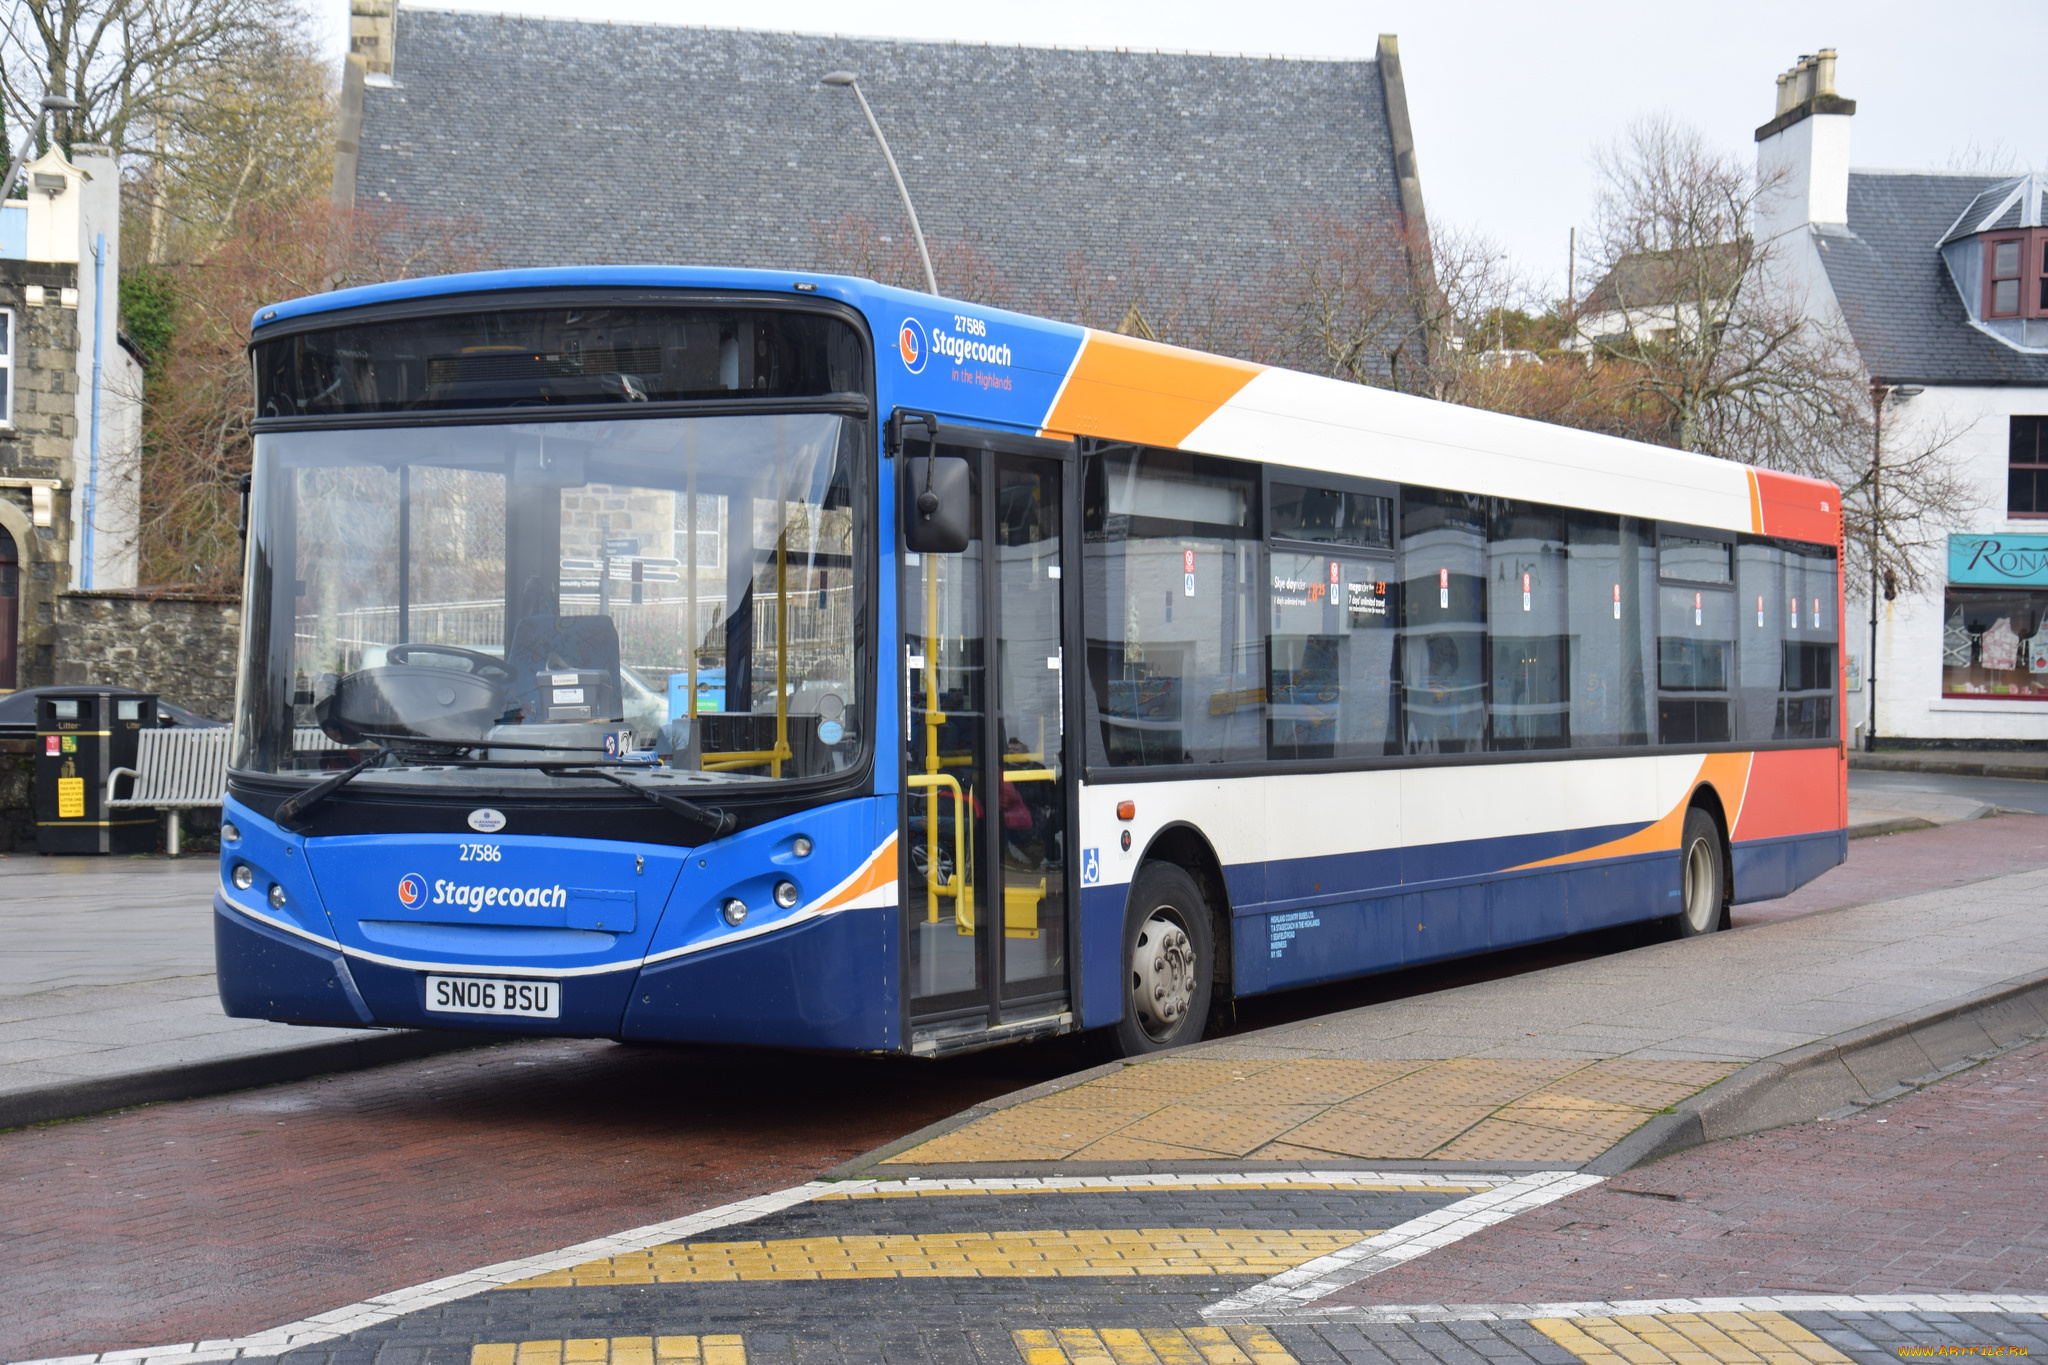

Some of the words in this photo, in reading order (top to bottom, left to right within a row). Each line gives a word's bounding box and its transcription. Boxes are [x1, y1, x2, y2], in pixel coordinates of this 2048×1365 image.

[955, 315, 986, 337] 27586
[932, 328, 1011, 366] Stagecoach
[952, 367, 959, 381] in
[961, 368, 973, 384] the
[975, 369, 1012, 390] Highlands
[459, 844, 501, 862] 27586
[433, 879, 566, 913] Stagecoach
[437, 980, 496, 1009] SN06
[503, 984, 548, 1012] BSU
